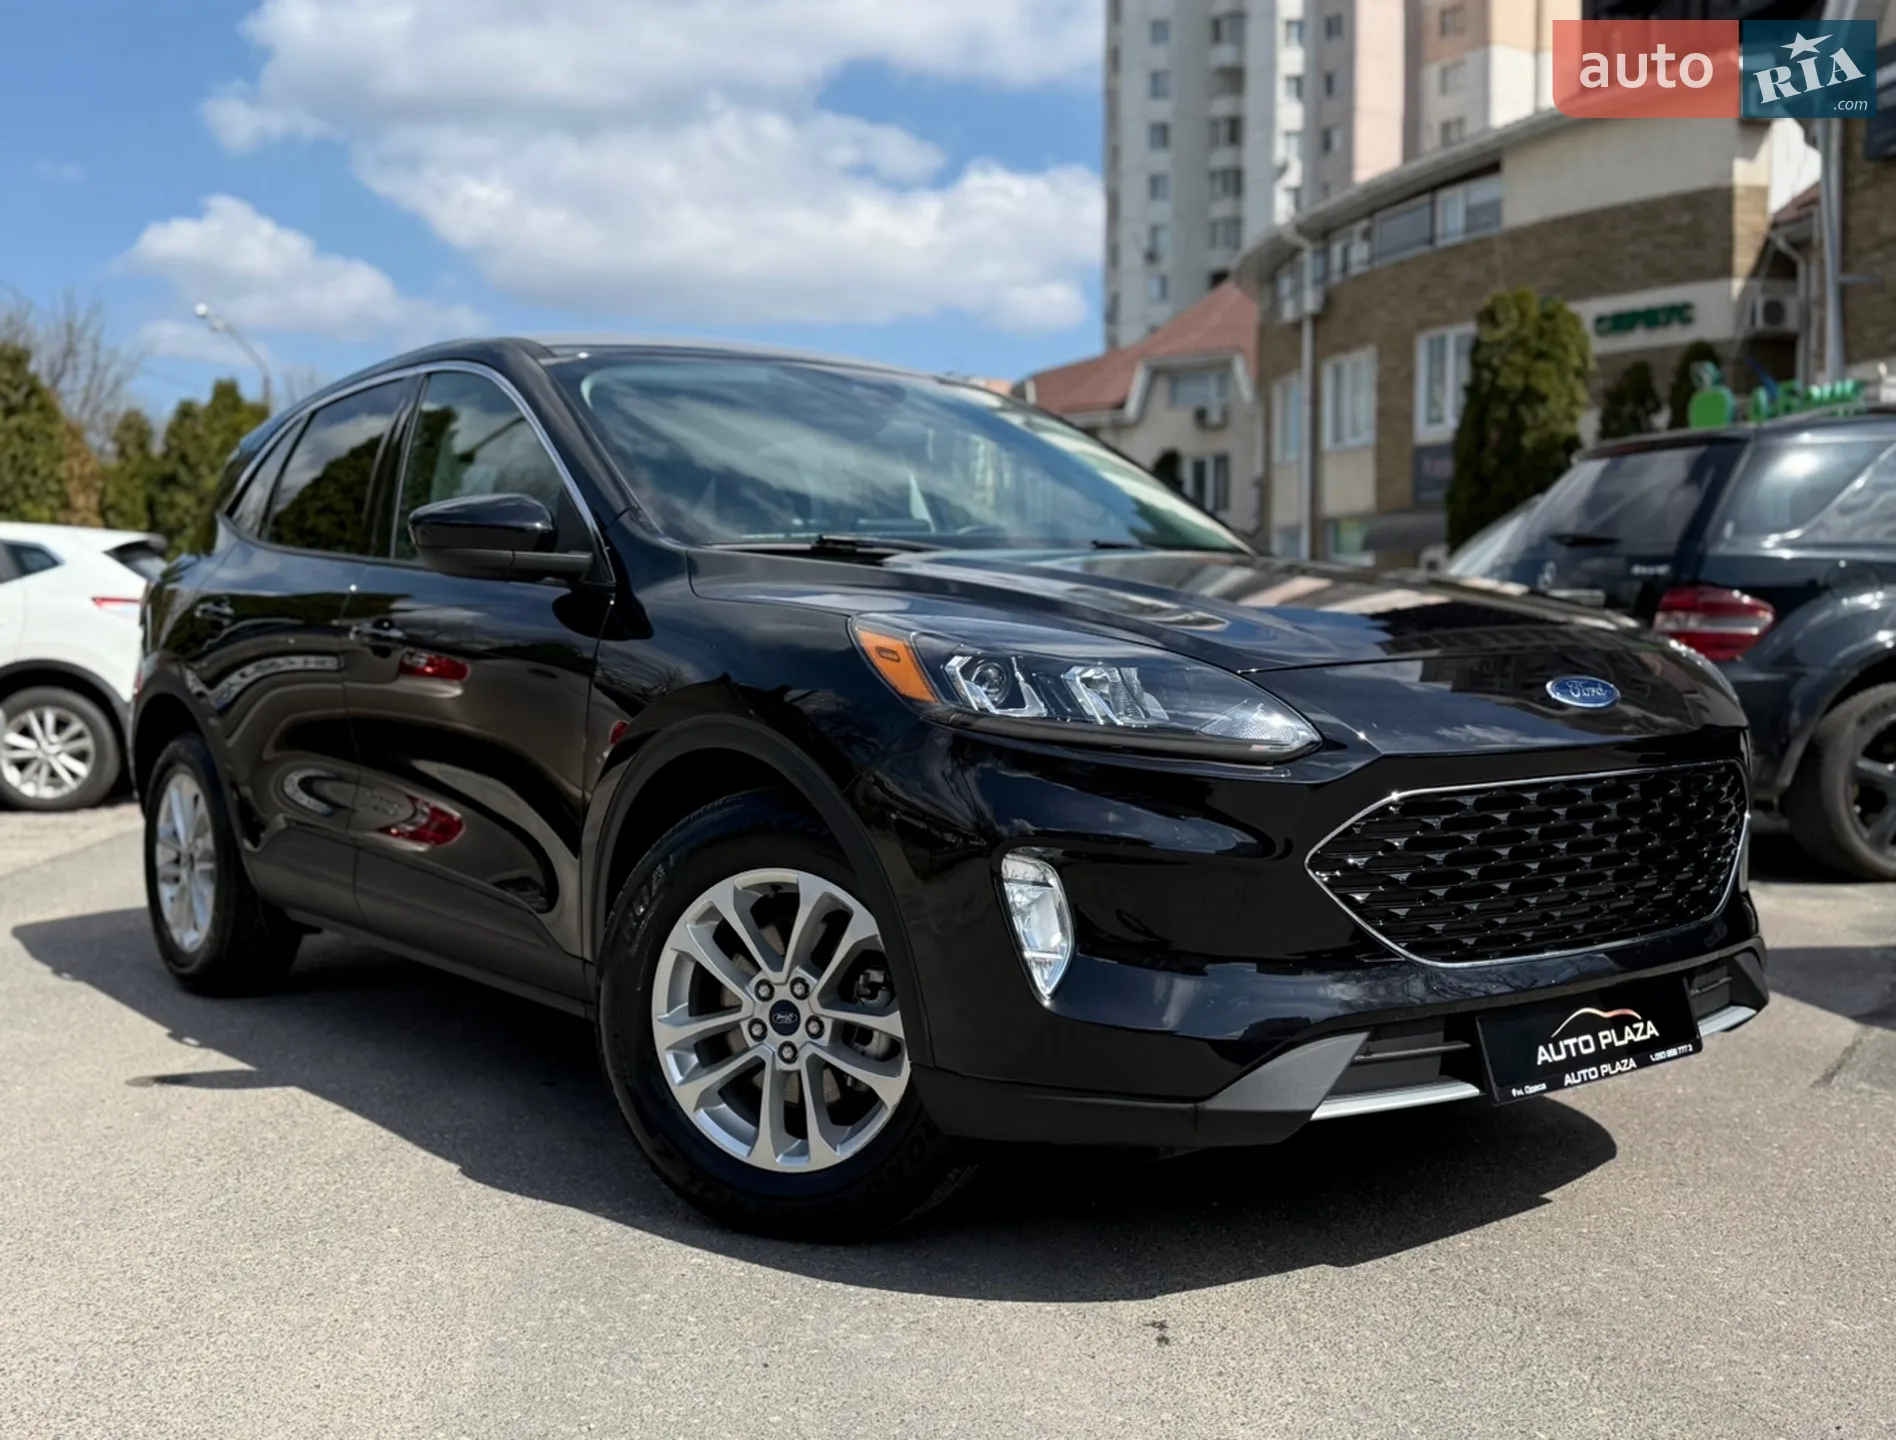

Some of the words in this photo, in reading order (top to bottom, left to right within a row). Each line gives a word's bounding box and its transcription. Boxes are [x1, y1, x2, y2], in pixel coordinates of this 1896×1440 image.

[1565, 680, 1607, 698] Ford
[1536, 1034, 1596, 1065] AUTO
[1598, 1020, 1659, 1049] PLAZA
[1563, 1066, 1598, 1086] AUTO
[1600, 1058, 1637, 1076] PLAZA
